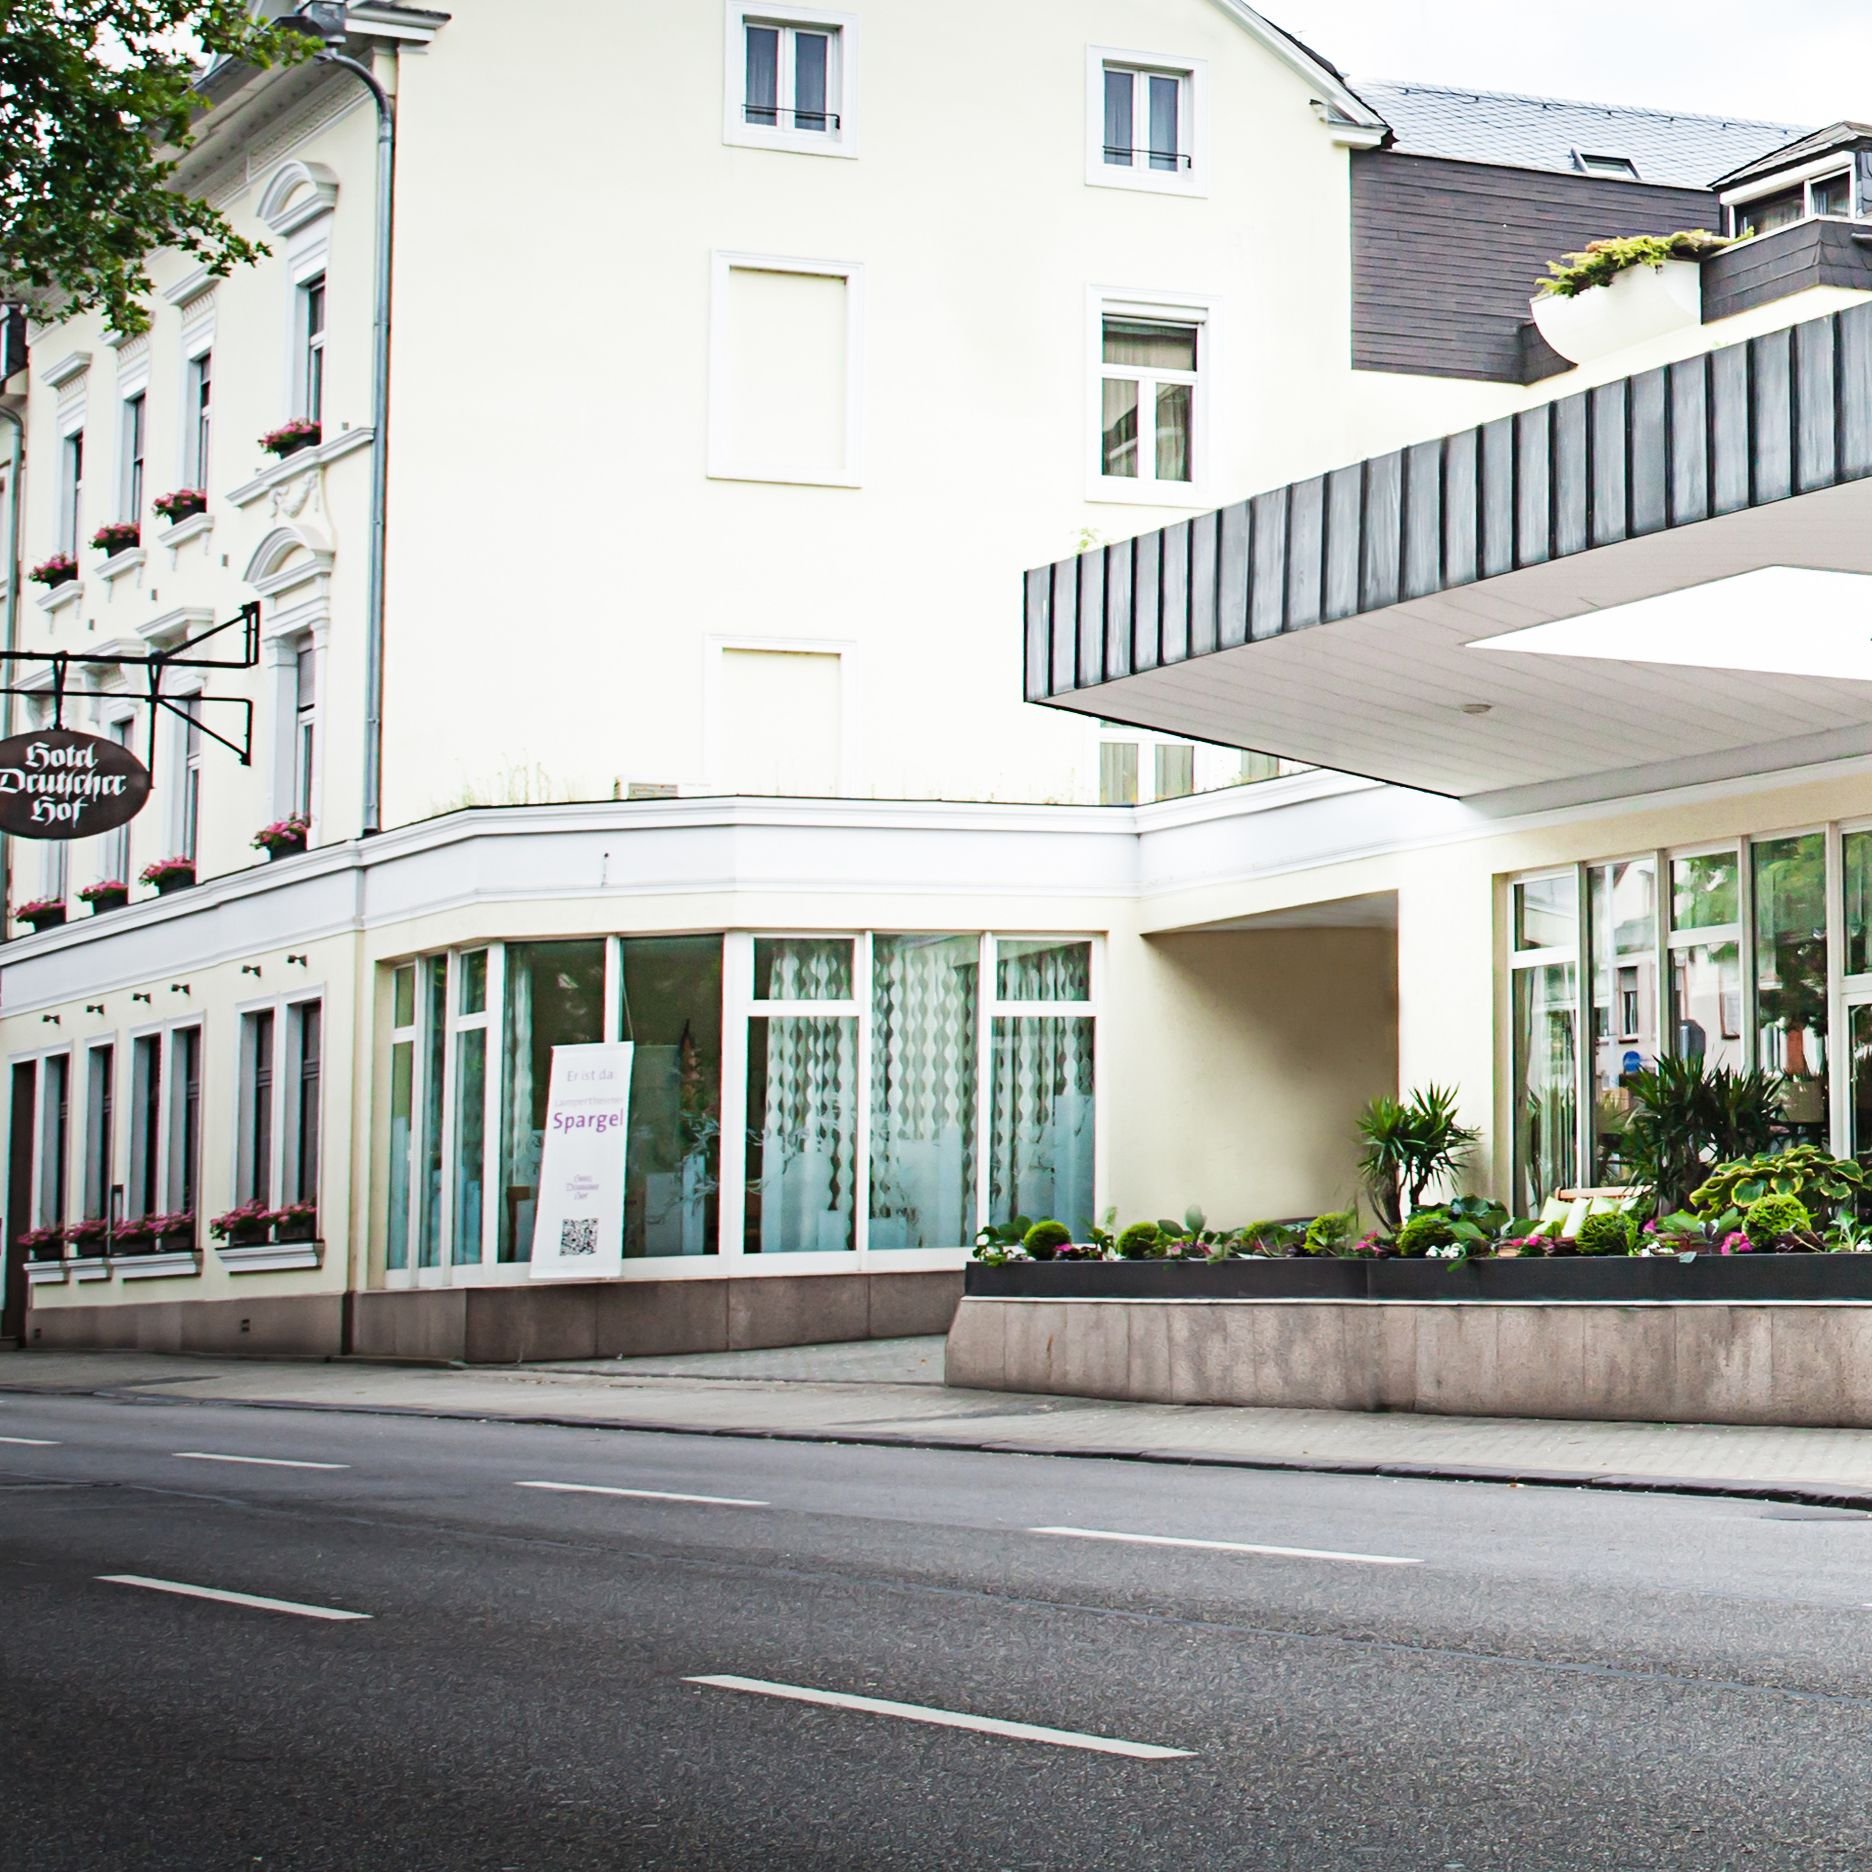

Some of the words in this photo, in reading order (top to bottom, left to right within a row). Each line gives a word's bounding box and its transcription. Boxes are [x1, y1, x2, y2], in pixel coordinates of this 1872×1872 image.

[25, 741, 99, 772] Hotel
[30, 795, 89, 829] Hof
[553, 1107, 624, 1134] Spargel
